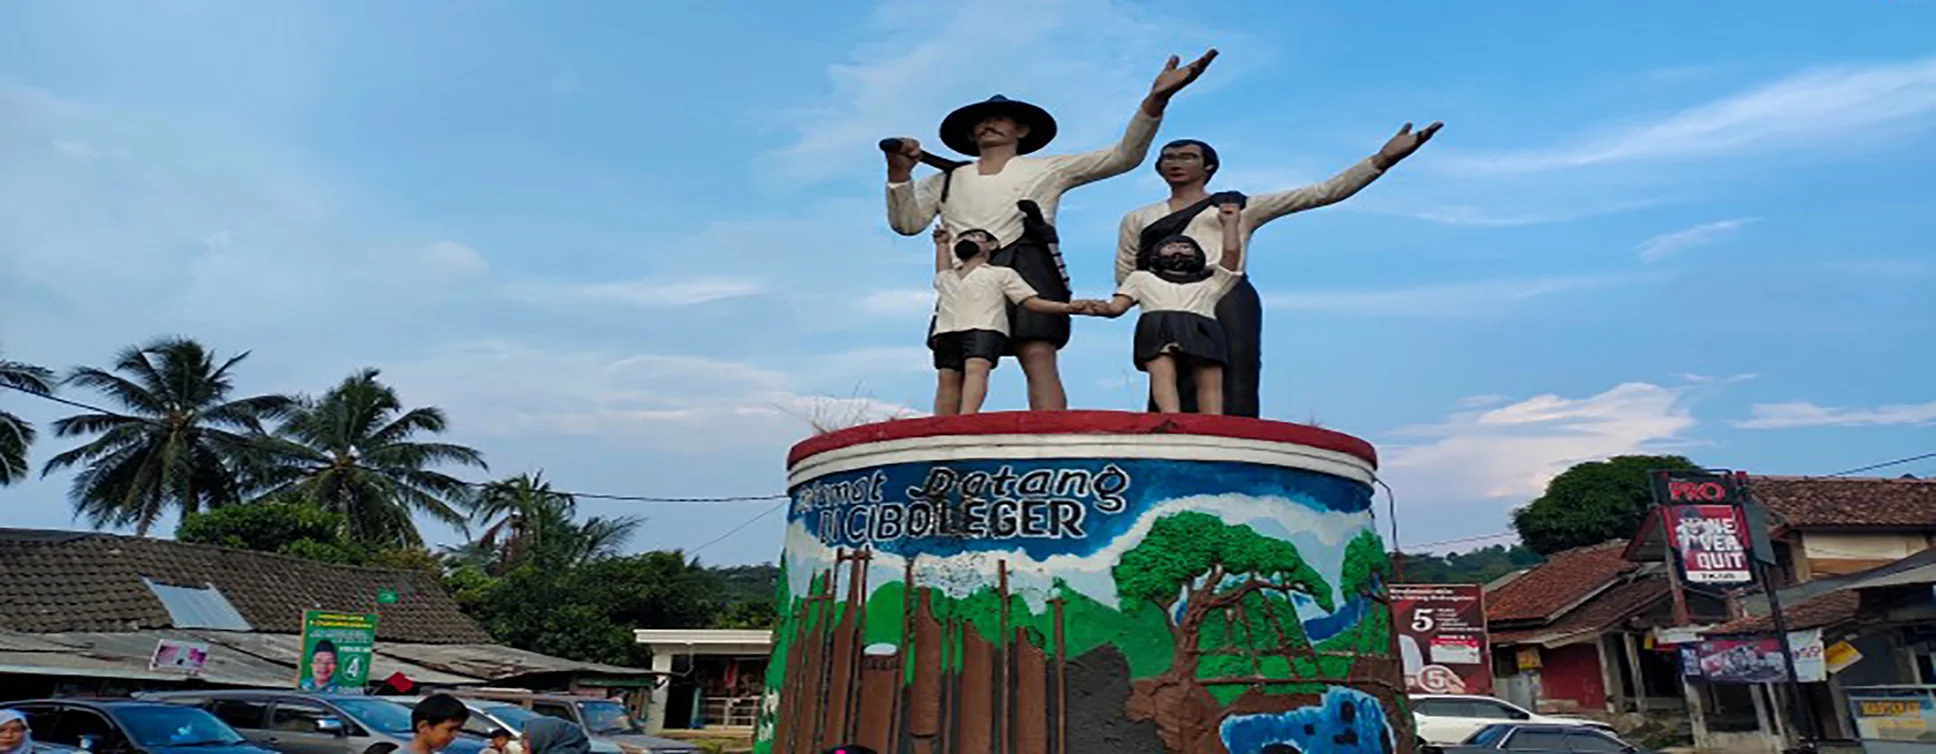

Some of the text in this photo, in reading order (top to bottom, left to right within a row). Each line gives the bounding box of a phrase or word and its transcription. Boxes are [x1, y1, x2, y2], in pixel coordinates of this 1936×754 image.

[906, 464, 1132, 513] Datang
[1669, 482, 1725, 501] PRO
[844, 498, 1086, 543] CIBOLEGER
[1697, 552, 1743, 569] QUIT
[1411, 608, 1434, 632] 5
[347, 657, 360, 677] 4
[1427, 670, 1445, 689] 5
